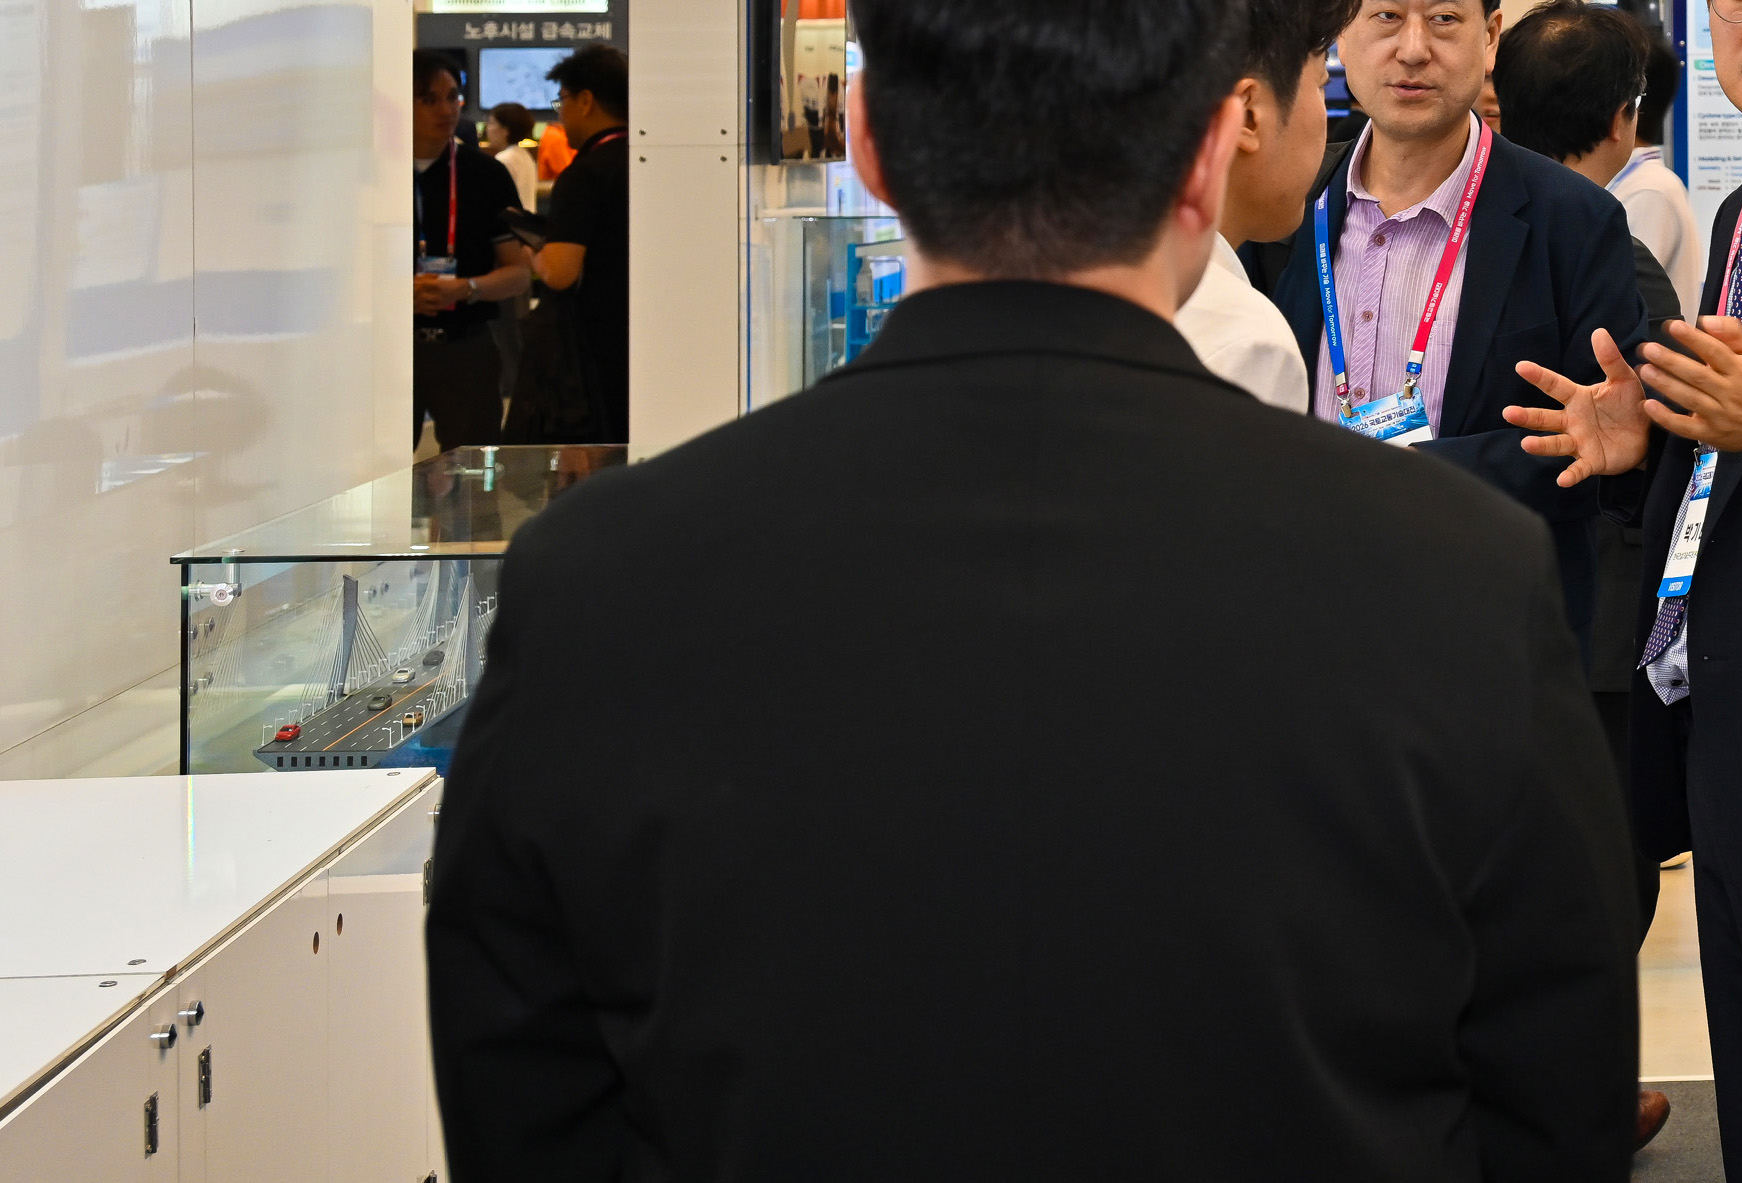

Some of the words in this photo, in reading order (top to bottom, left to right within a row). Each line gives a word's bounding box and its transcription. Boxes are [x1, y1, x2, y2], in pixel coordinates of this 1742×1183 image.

[463, 20, 536, 41] 노후시설
[1474, 146, 1487, 174] Tomorrow
[1328, 314, 1338, 347] Tomorrow
[1351, 421, 1369, 433] 2026
[1369, 405, 1416, 426] 국토교통기술대전
